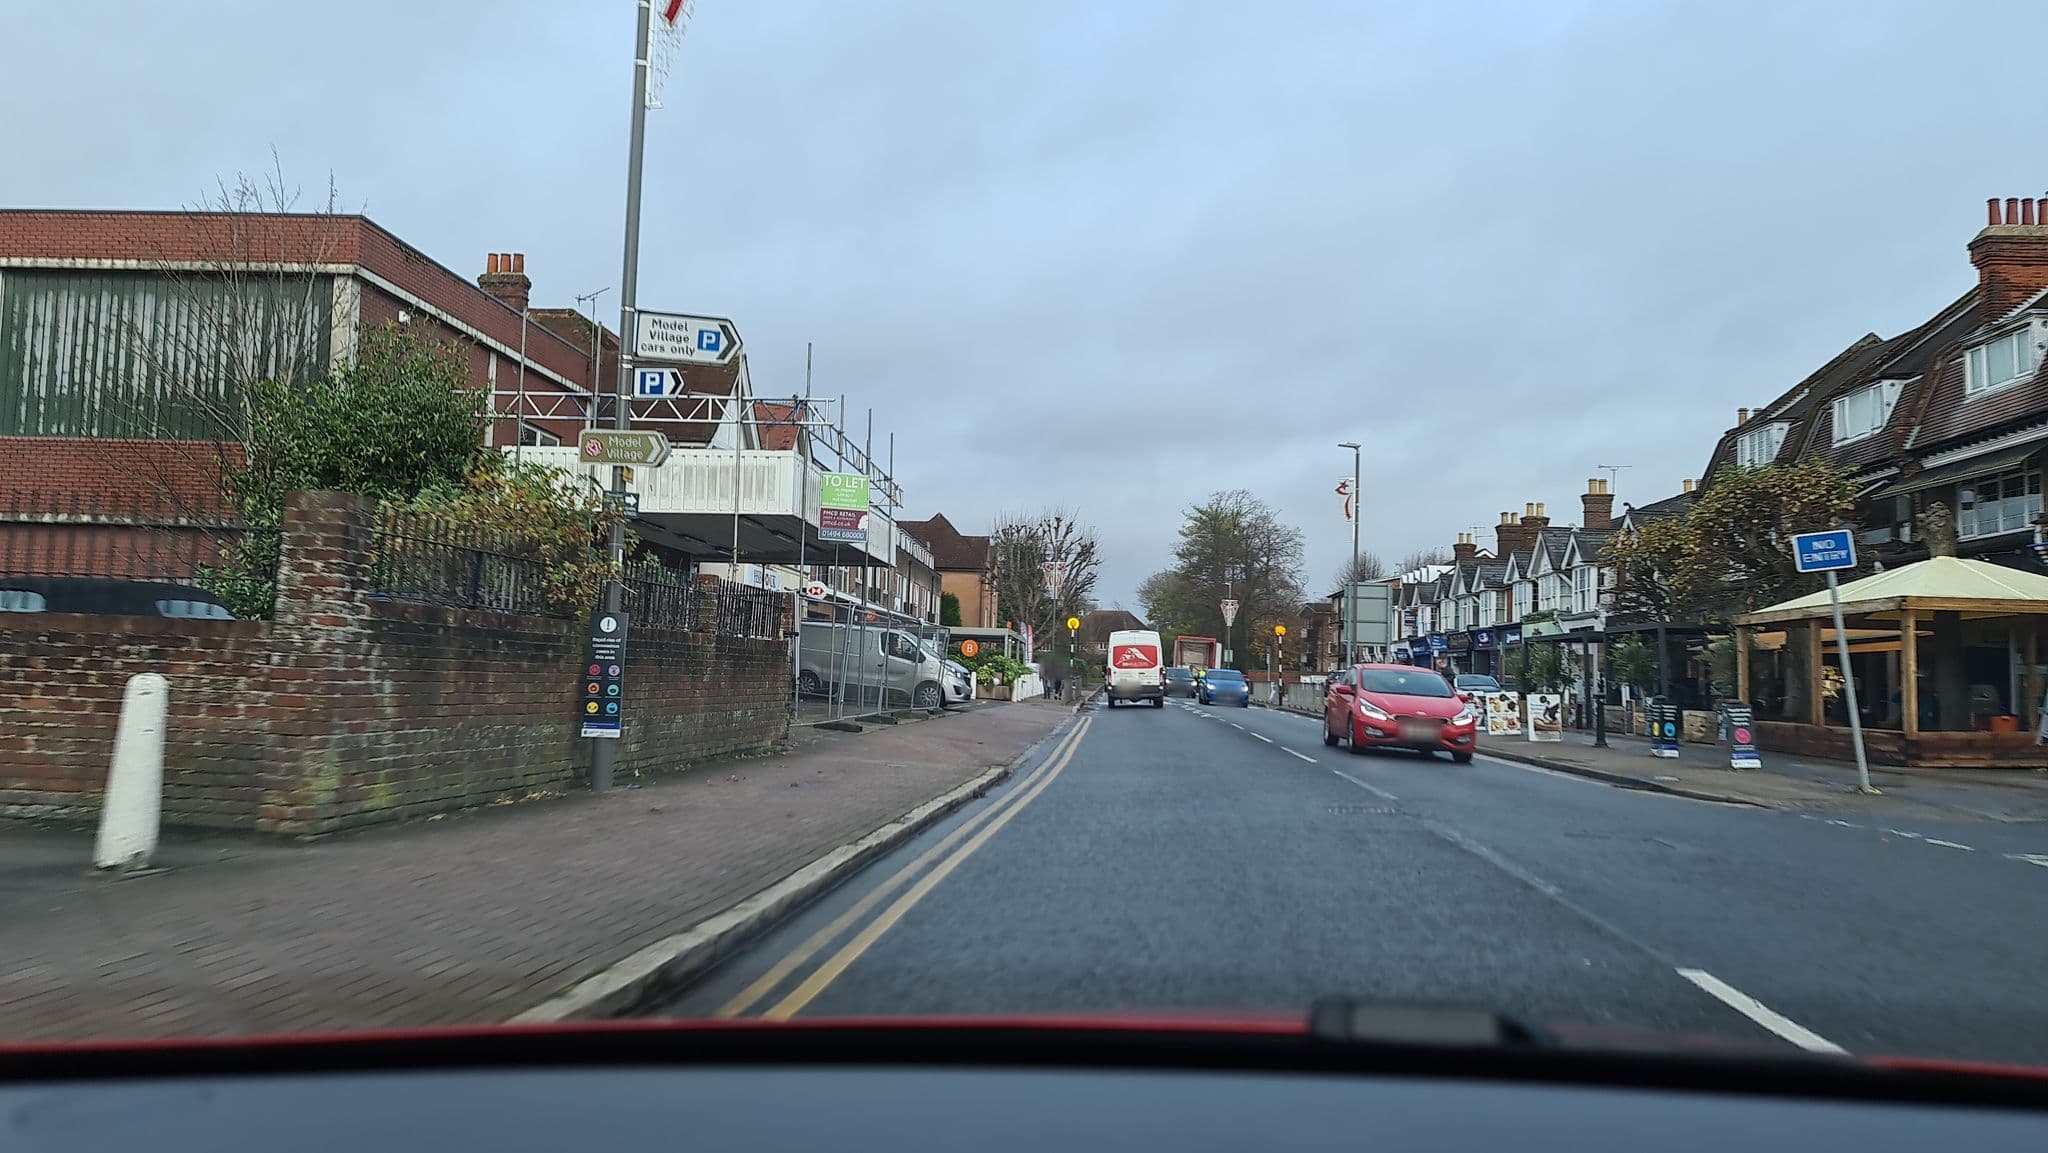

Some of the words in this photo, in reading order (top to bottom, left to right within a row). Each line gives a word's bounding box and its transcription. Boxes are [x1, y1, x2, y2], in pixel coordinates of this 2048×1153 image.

[651, 319, 689, 332] Model
[649, 331, 690, 344] Village
[703, 331, 716, 350] P
[640, 343, 665, 353] cars
[670, 345, 696, 357] only
[645, 371, 661, 395] P
[608, 435, 642, 448] Model
[606, 447, 644, 460] Village
[823, 475, 842, 486] TO
[846, 476, 866, 488] LET
[1812, 540, 1836, 550] NO
[1802, 550, 1848, 562] ENTRY
